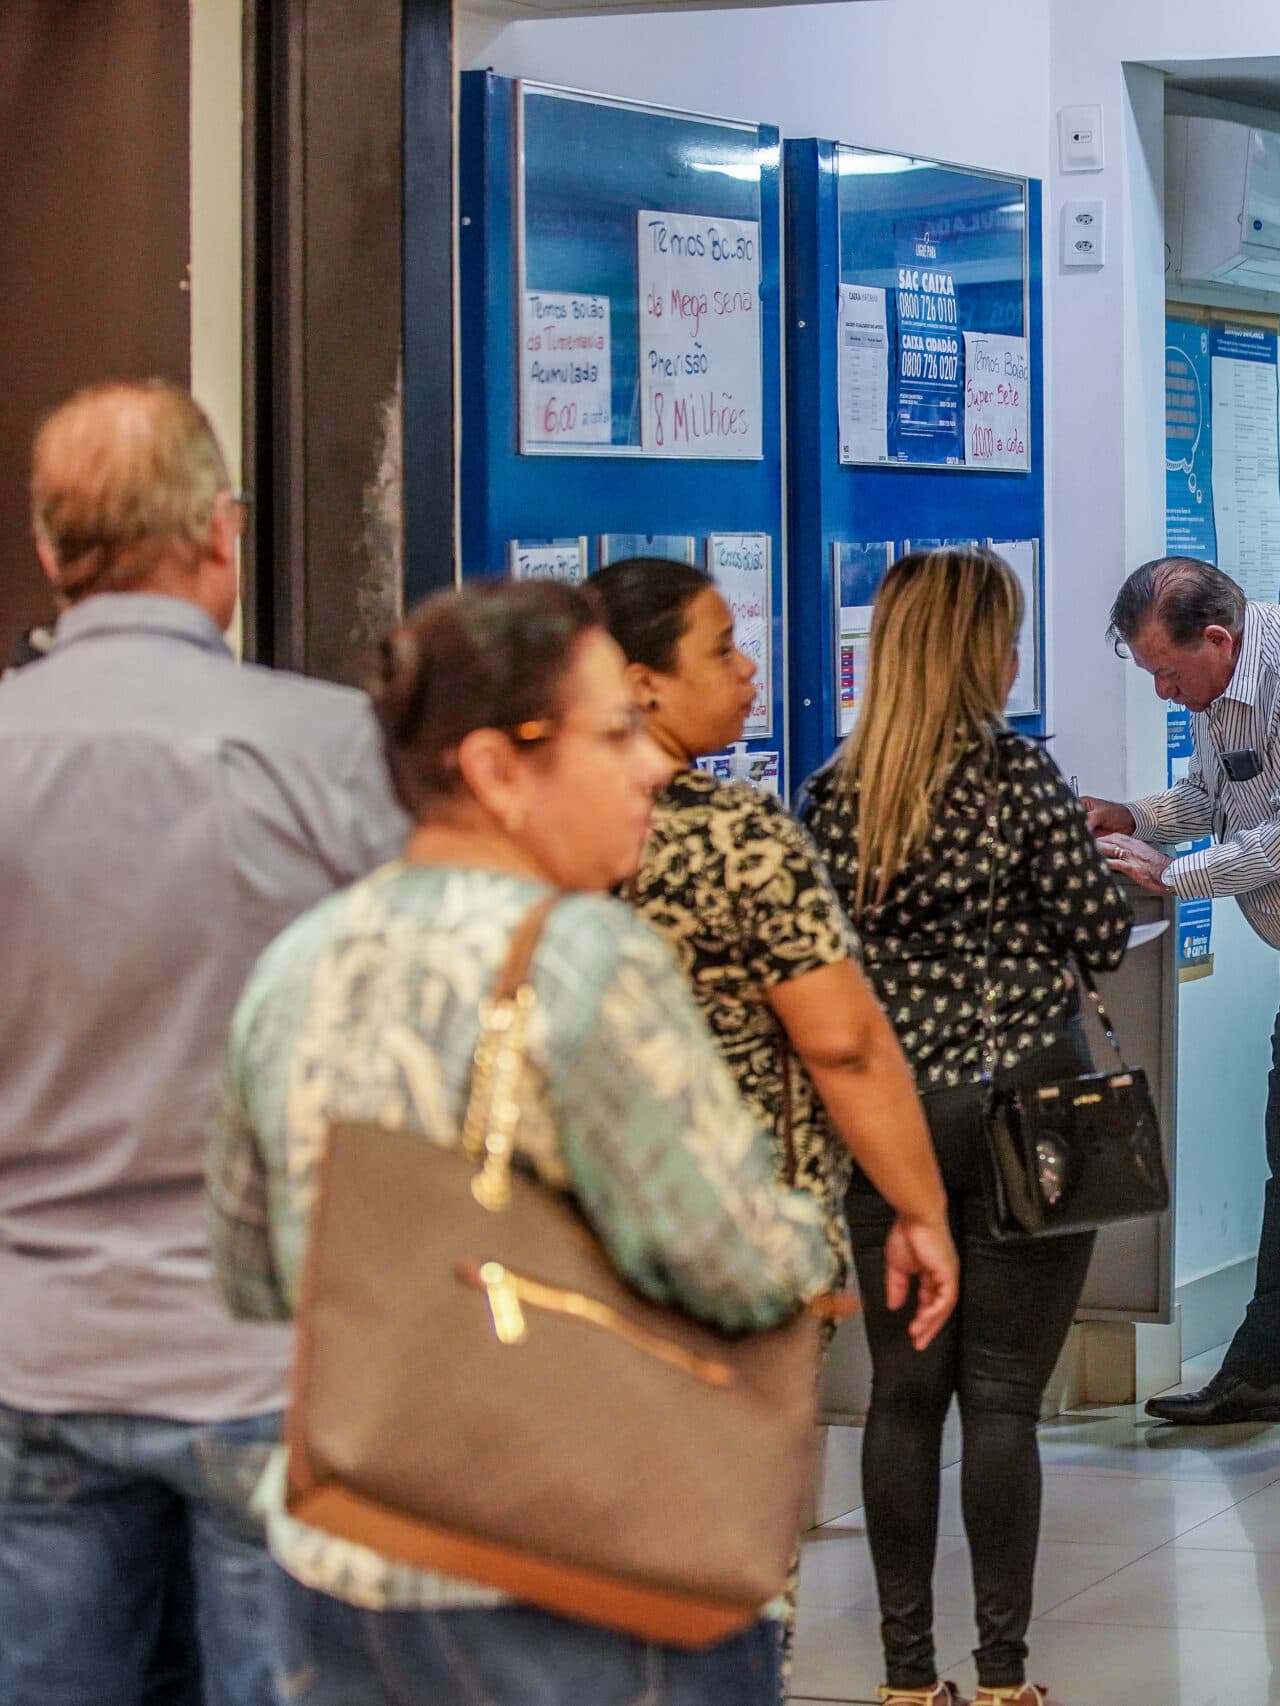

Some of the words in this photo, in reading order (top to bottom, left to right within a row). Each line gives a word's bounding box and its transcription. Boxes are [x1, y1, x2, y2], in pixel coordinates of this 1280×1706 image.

[648, 221, 705, 257] Temos
[899, 269, 918, 291] SAC
[922, 272, 954, 296] CAIXA
[671, 289, 708, 338] Mega
[900, 292, 919, 318] 0800
[921, 294, 936, 321] 726
[938, 297, 957, 323] 0101
[902, 334, 924, 351] CAIXA
[926, 336, 958, 354] CIDADÃO
[971, 340, 1000, 374] Temos
[902, 351, 921, 378] 0800
[923, 353, 937, 379] 726
[940, 355, 958, 381] 0207
[967, 379, 993, 412] Super
[655, 392, 664, 446] 8
[1007, 428, 1024, 455] cota
